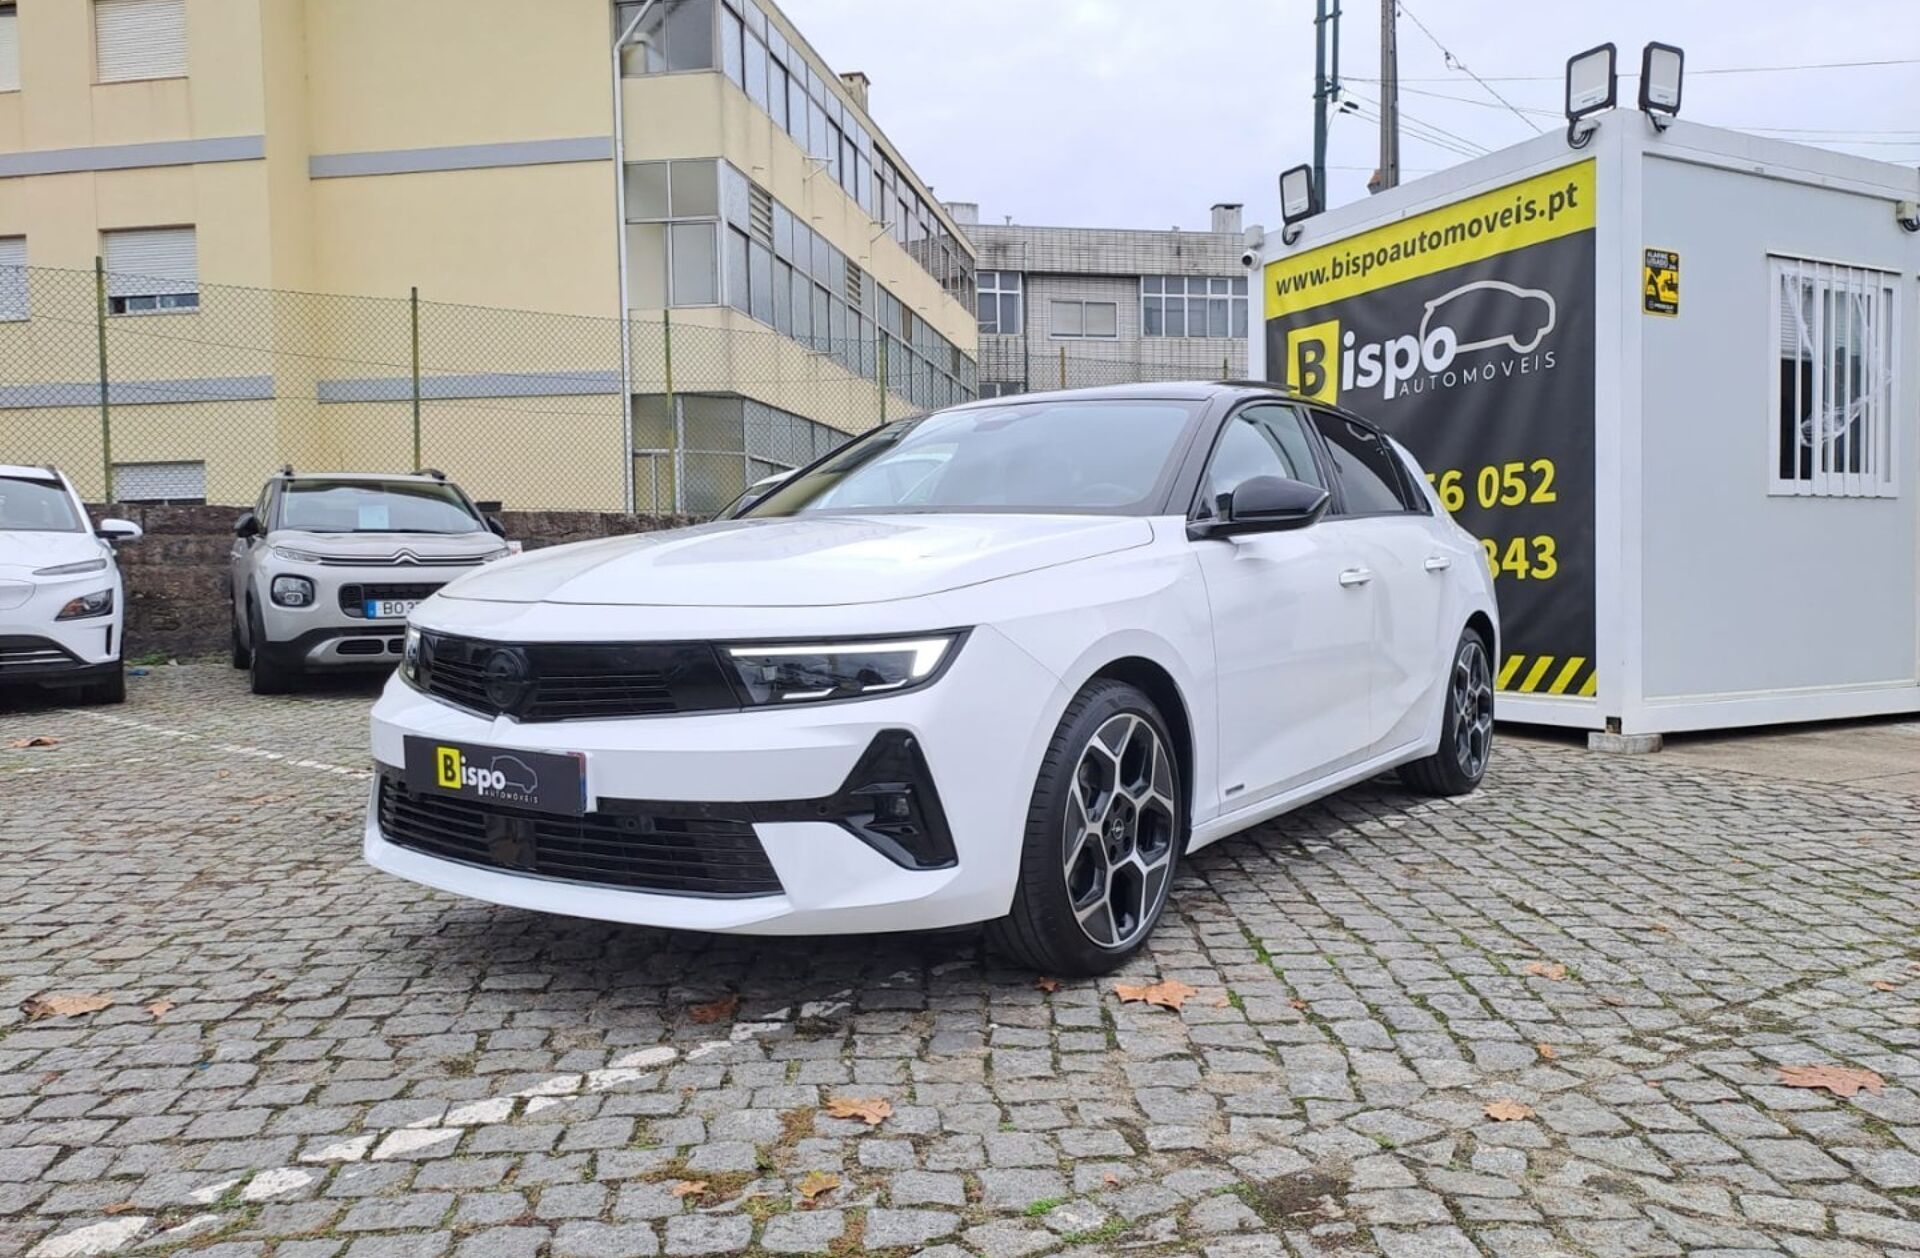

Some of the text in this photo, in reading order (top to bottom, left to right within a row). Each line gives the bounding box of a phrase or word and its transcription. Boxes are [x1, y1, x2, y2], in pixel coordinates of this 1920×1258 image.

[1276, 182, 1579, 296] www.bispoautomoveis.pt
[1296, 326, 1457, 400] Bispo
[1399, 351, 1557, 397] AUTOMÓVEIS
[1425, 458, 1557, 512] 6 052
[384, 601, 404, 615] BO
[441, 752, 506, 796] Bispo
[484, 789, 539, 804] AUTOMÓVEIS
